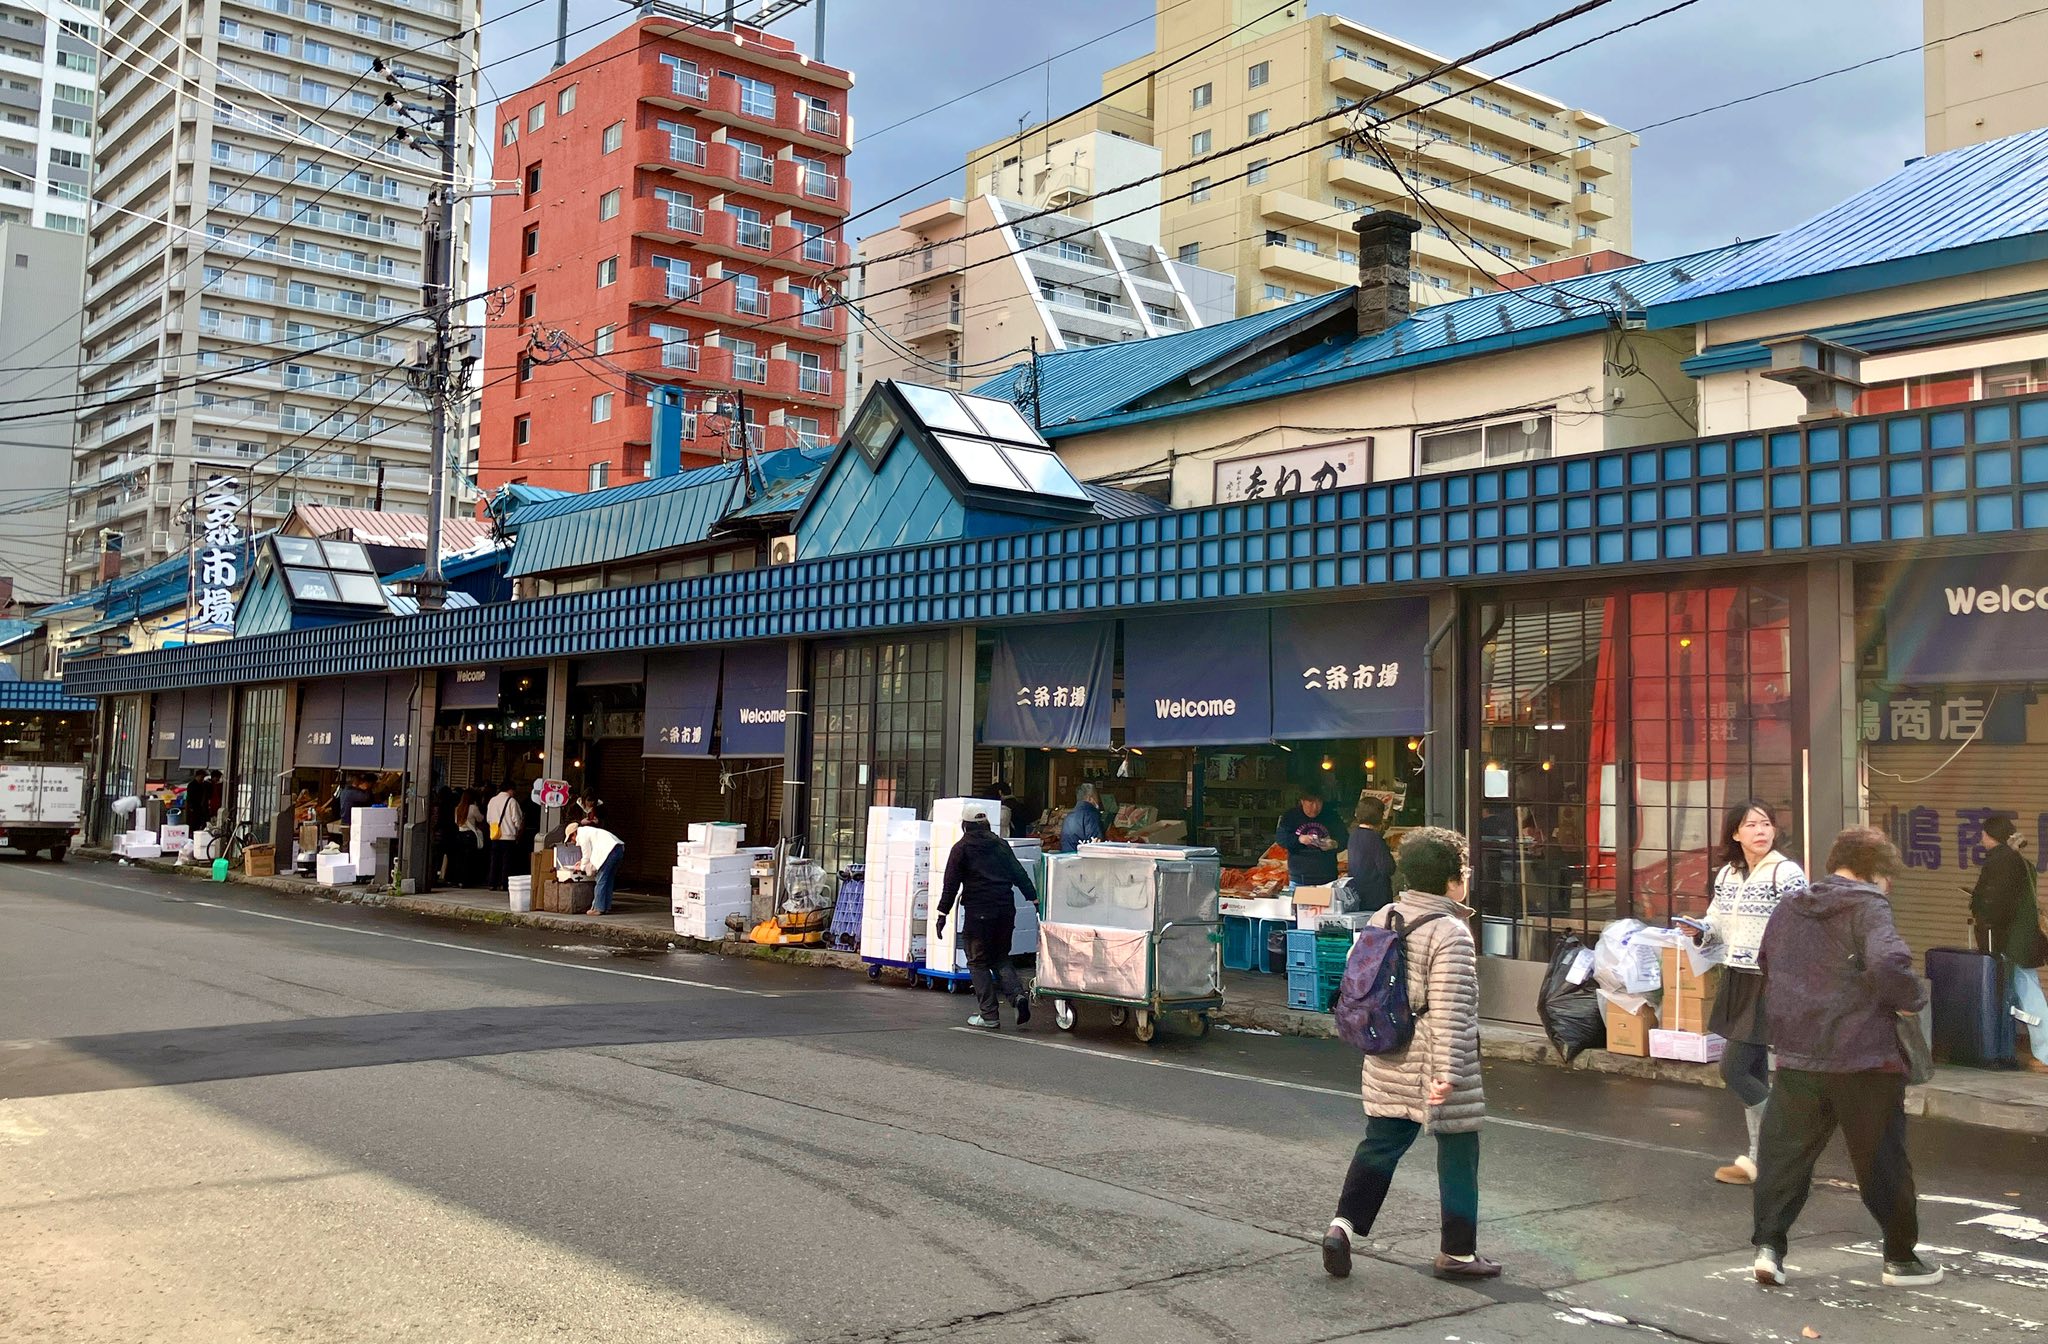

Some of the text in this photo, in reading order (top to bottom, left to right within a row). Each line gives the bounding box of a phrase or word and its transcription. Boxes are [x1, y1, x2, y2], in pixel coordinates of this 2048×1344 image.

[199, 475, 241, 625] 二条市場
[456, 669, 486, 683] Welcome
[1303, 662, 1399, 691] 二条市場
[1016, 685, 1086, 708] 二条市場
[739, 707, 786, 724] Welcome
[1155, 697, 1236, 719] Welcome
[350, 733, 374, 746] Welcome
[660, 726, 702, 744] 二条市場
